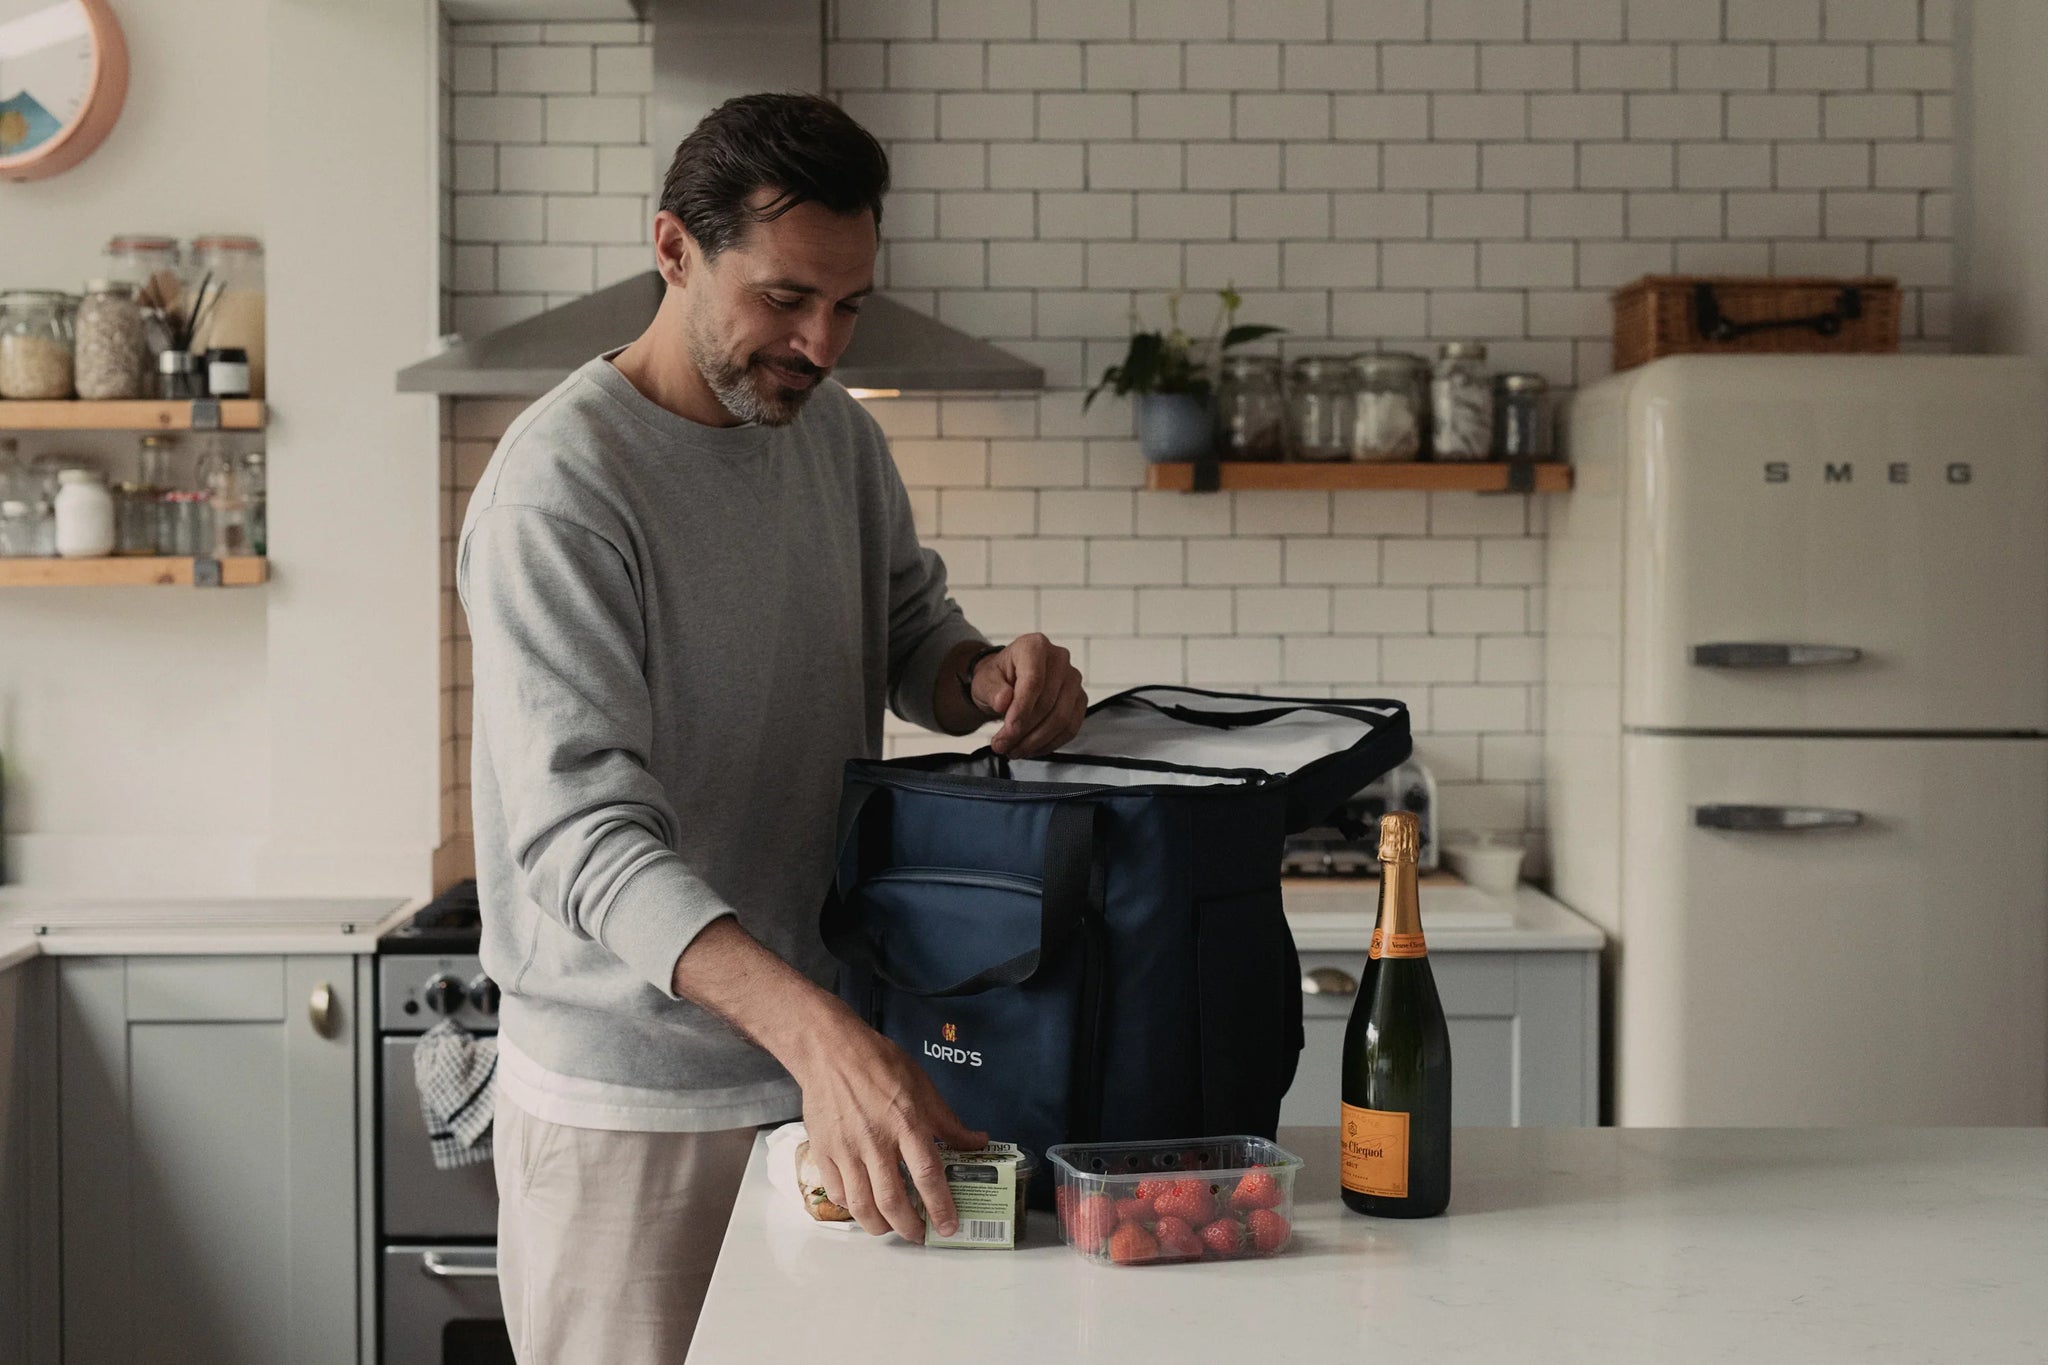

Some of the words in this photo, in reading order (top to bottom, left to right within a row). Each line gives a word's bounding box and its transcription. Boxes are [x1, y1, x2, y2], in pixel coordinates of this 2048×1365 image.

[1764, 460, 1973, 485] SMEG
[923, 1040, 983, 1067] LORD'S
[1349, 1140, 1383, 1158] Clicquot
